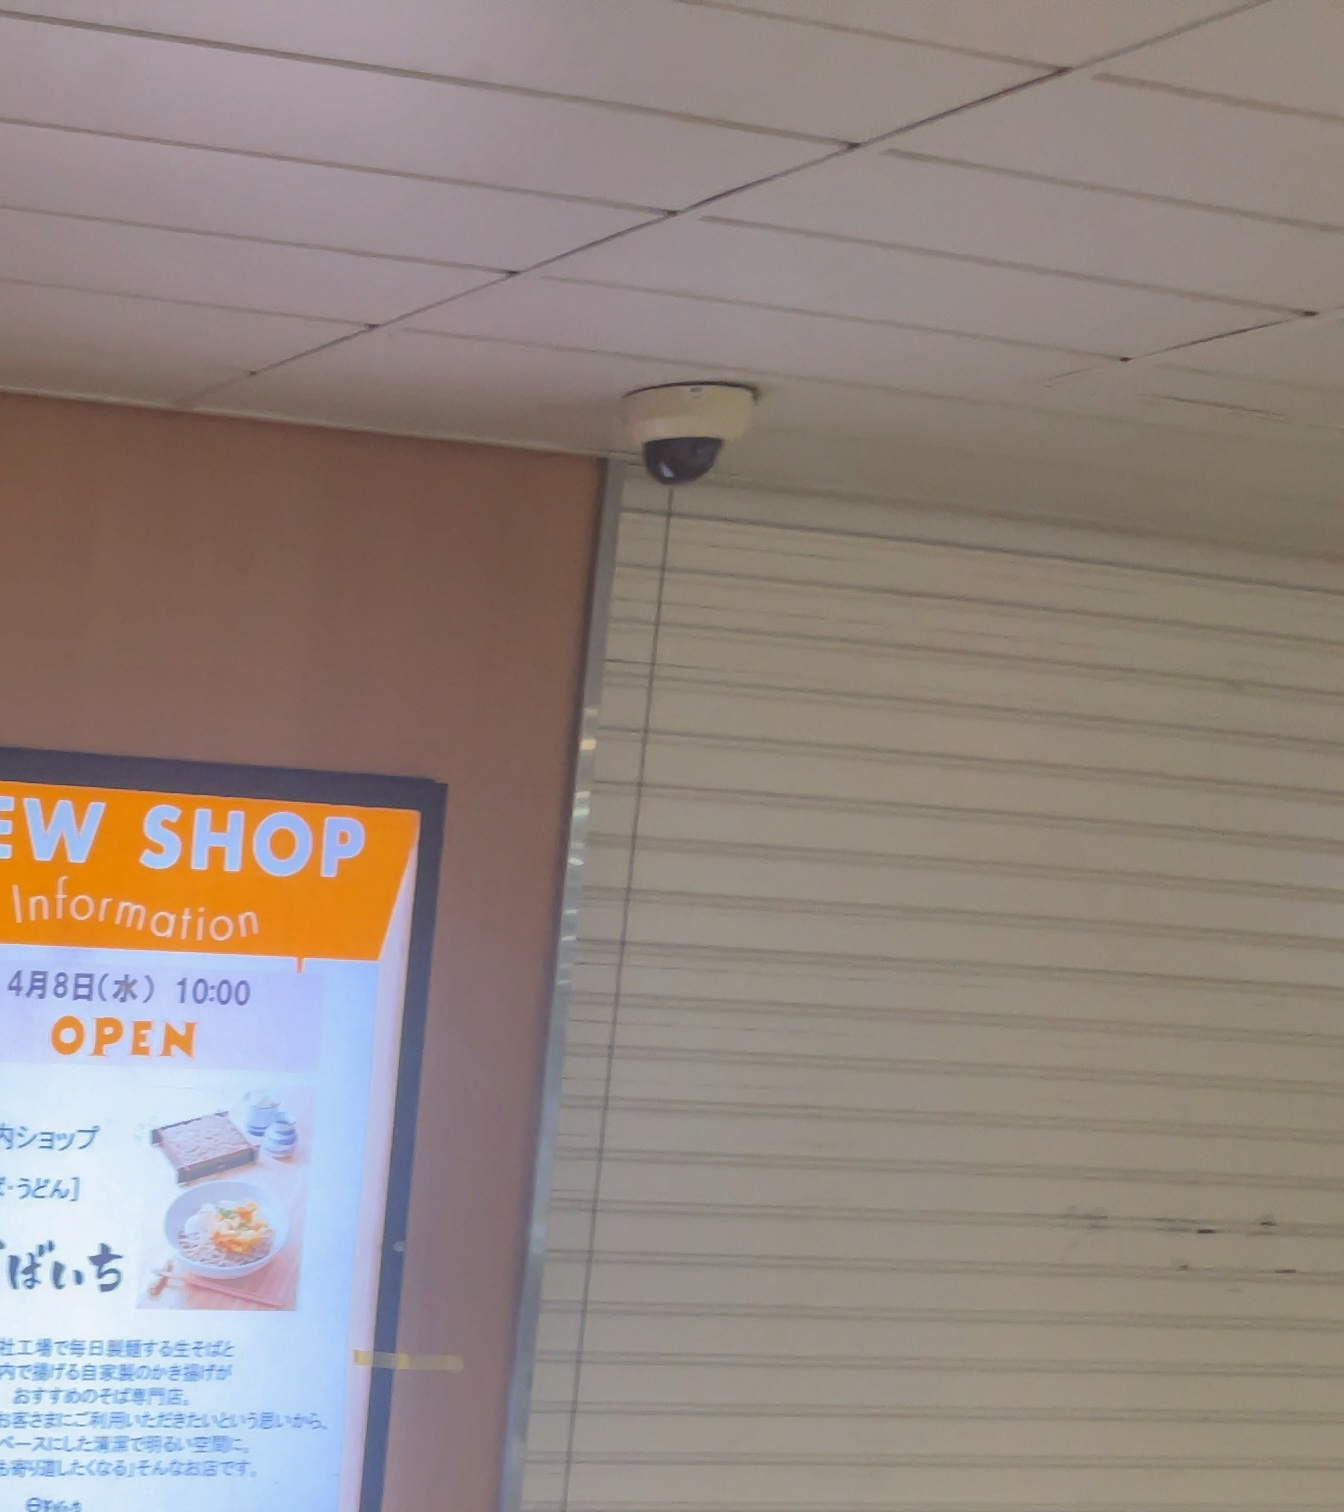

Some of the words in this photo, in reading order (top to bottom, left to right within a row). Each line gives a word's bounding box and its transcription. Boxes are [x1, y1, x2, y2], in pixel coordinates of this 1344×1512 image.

[138, 804, 365, 878] SHOP
[12, 876, 260, 942] Information
[176, 977, 251, 1006] 10:00
[50, 1015, 198, 1058] OPEN
